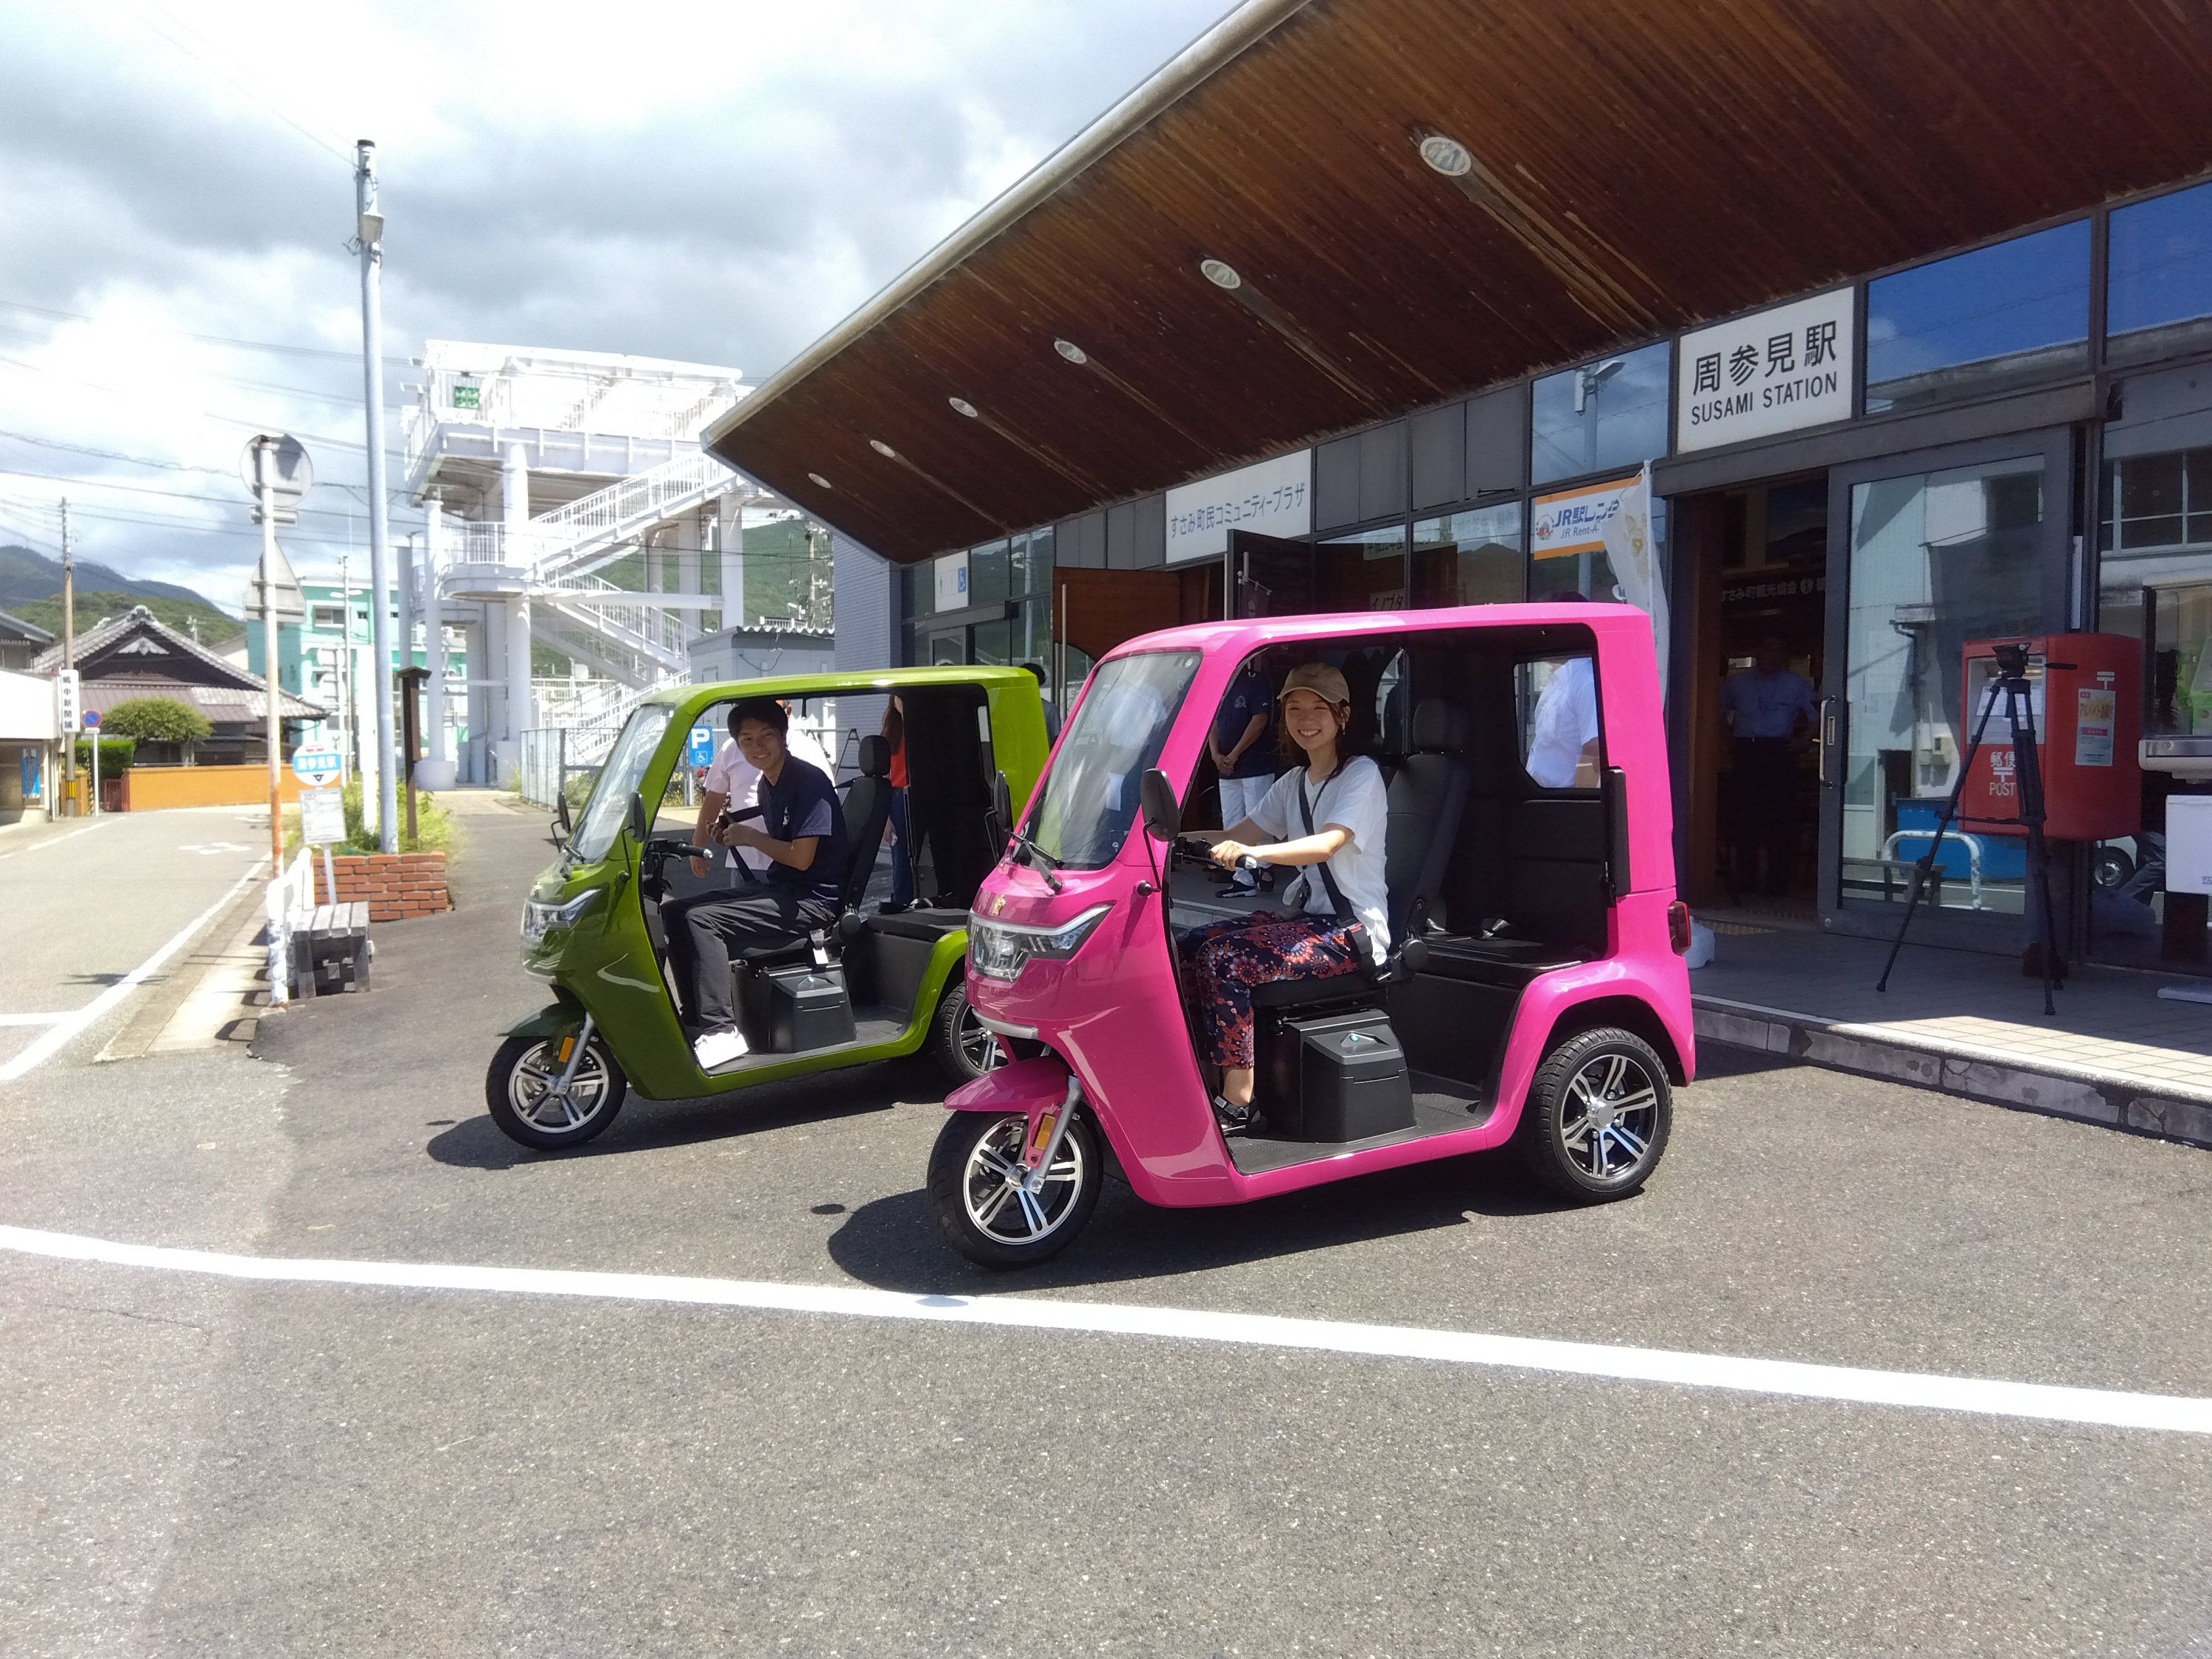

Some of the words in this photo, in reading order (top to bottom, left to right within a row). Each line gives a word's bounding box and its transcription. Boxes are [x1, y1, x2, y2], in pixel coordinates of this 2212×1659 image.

[1693, 320, 1837, 396] 周参見駅
[1691, 392, 1753, 425] SUSAMI
[1763, 371, 1837, 408] STATION
[1171, 482, 1305, 538] すさみ町民コミュニティープラザ
[1561, 528, 1571, 539] JR
[692, 728, 709, 748] P
[1989, 782, 2016, 796] POST
